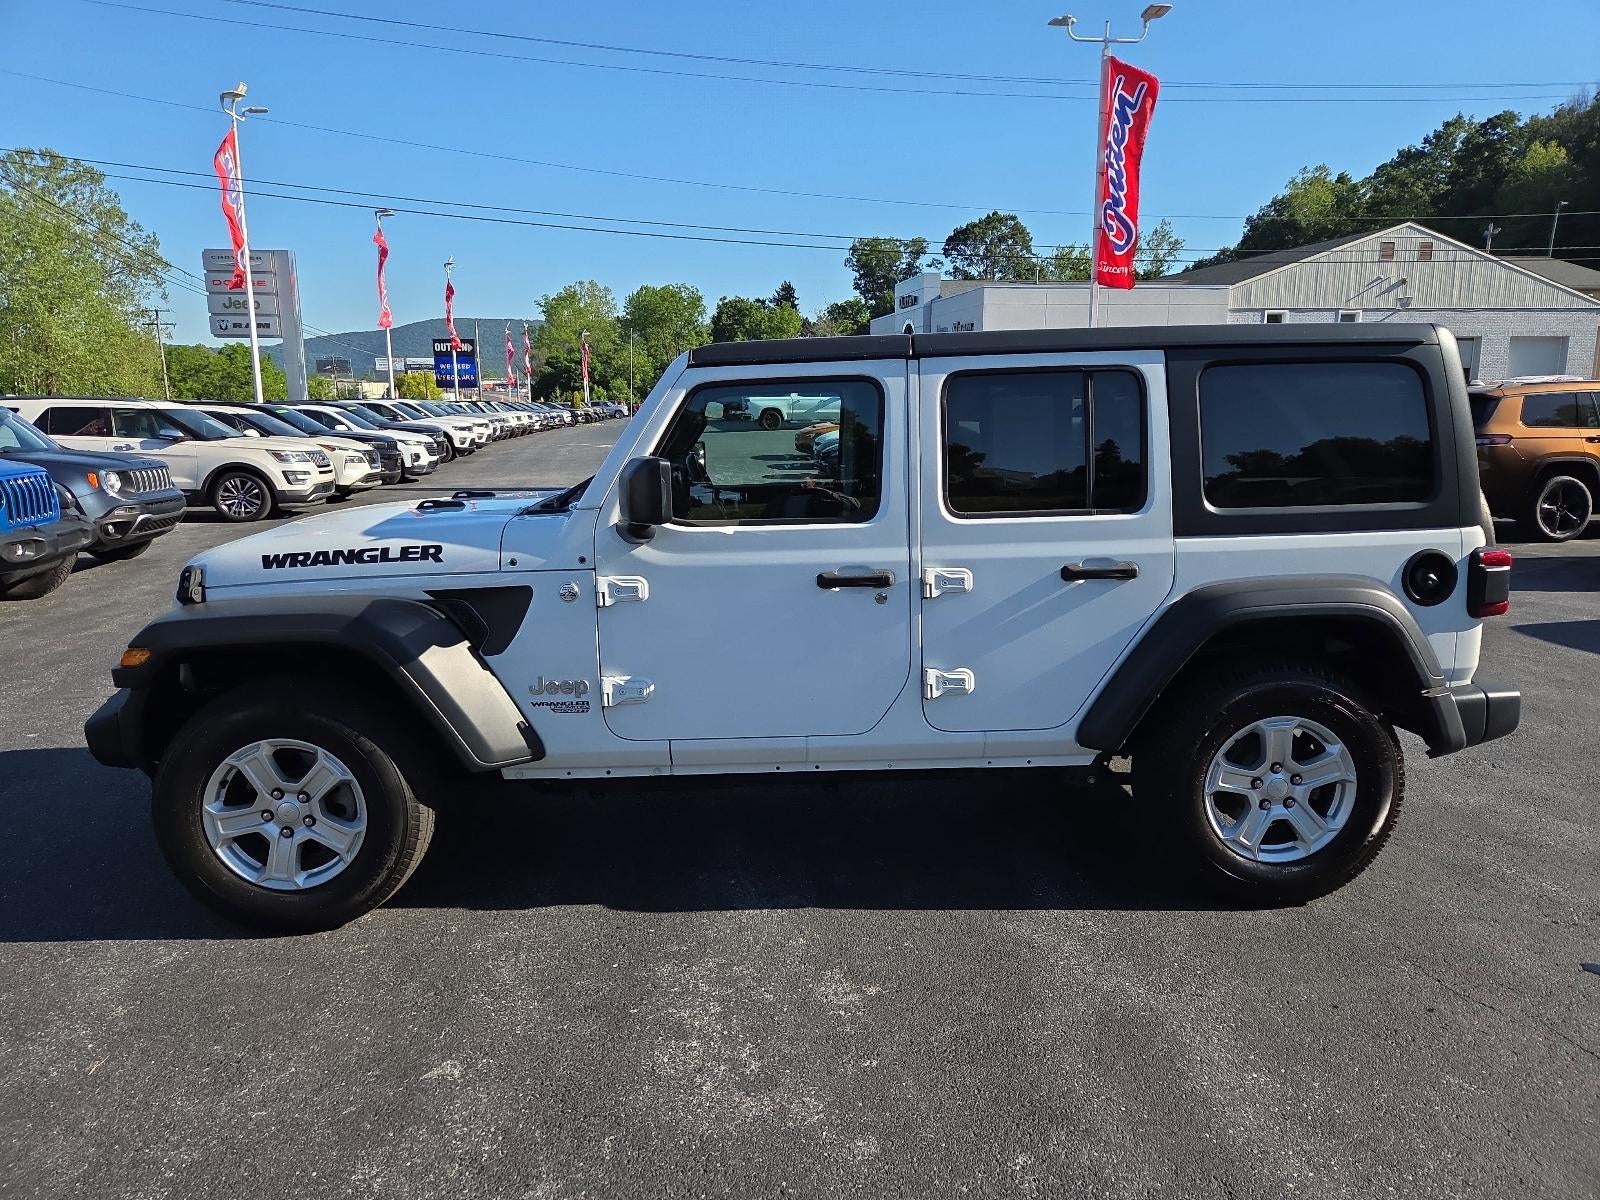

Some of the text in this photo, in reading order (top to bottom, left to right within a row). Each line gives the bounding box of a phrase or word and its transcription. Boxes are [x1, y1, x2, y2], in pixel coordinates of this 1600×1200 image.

[1102, 75, 1148, 255] Outten
[434, 342, 468, 352] OUTN
[261, 544, 444, 570] WRANGLER
[528, 675, 590, 698] Jeep
